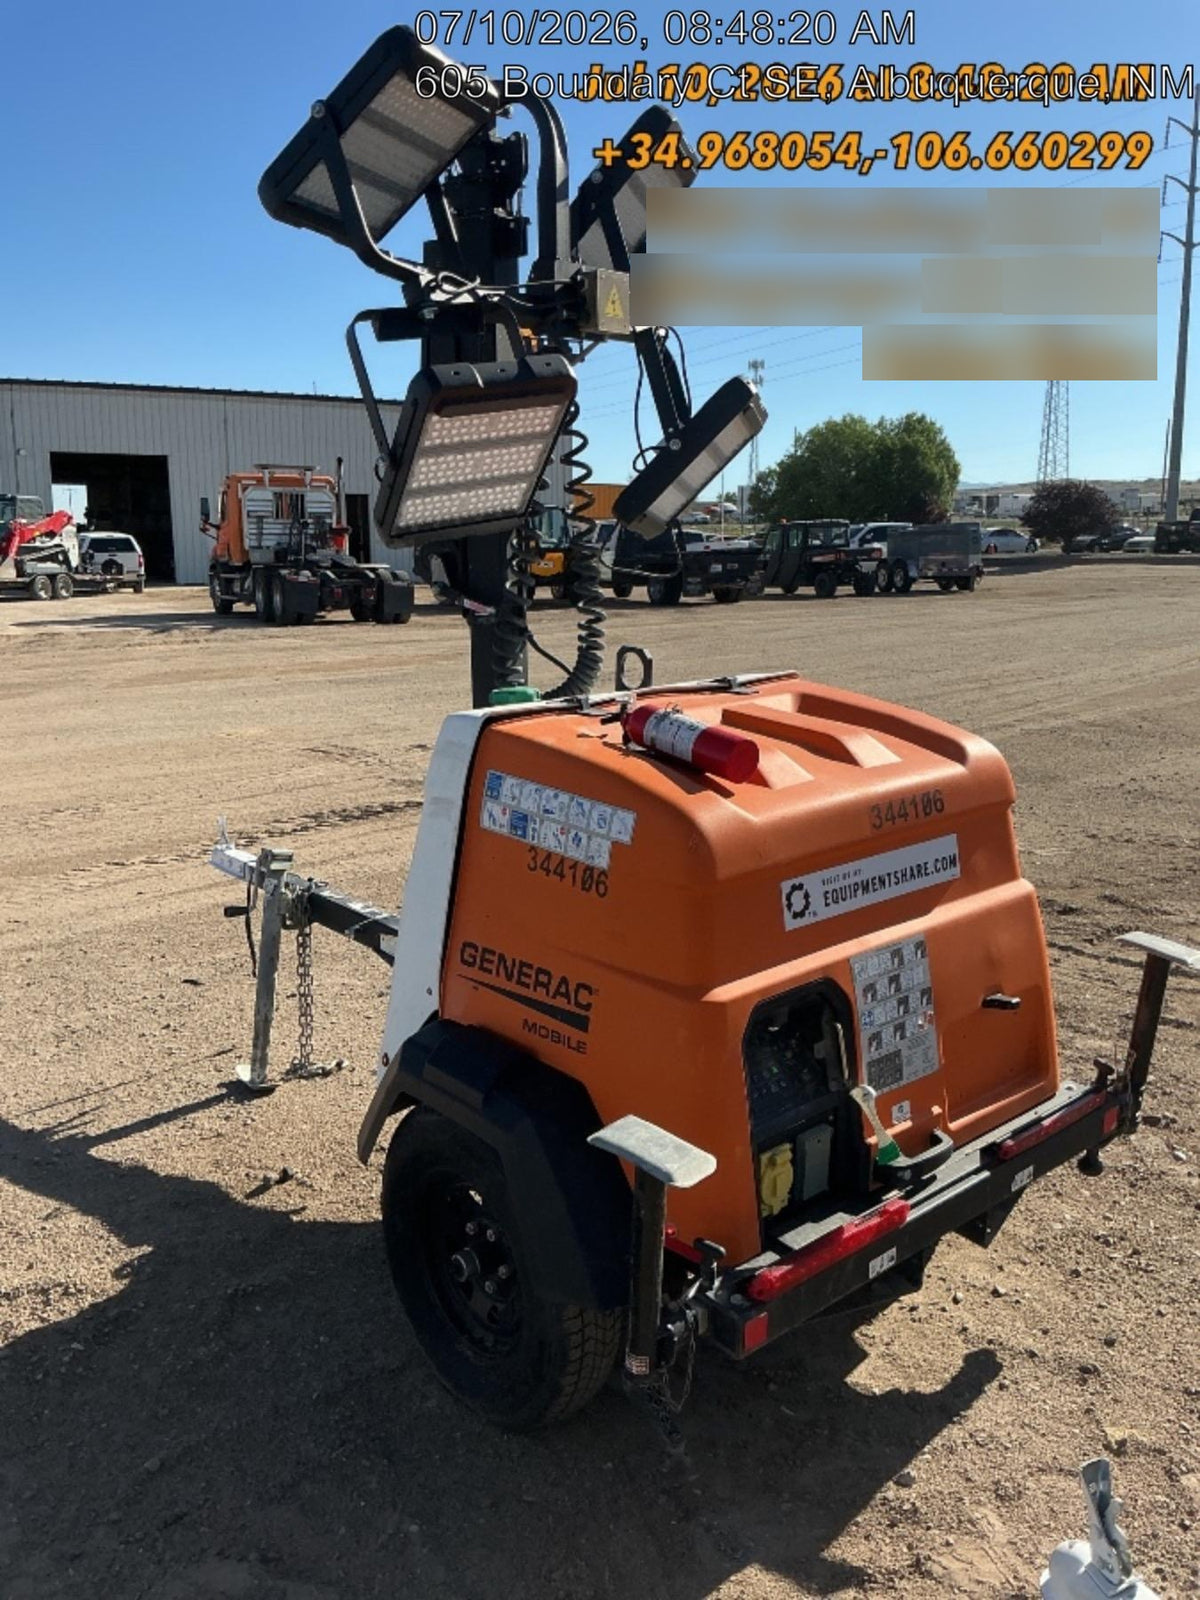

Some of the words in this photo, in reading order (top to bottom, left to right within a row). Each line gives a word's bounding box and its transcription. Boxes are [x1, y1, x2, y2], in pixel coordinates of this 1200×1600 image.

[871, 789, 945, 831] 344106
[527, 846, 609, 898] 344106
[823, 852, 957, 907] EQUIPMENTSHARE.COM
[459, 940, 593, 1013] GENERAC
[521, 1017, 588, 1055] MOBILE
